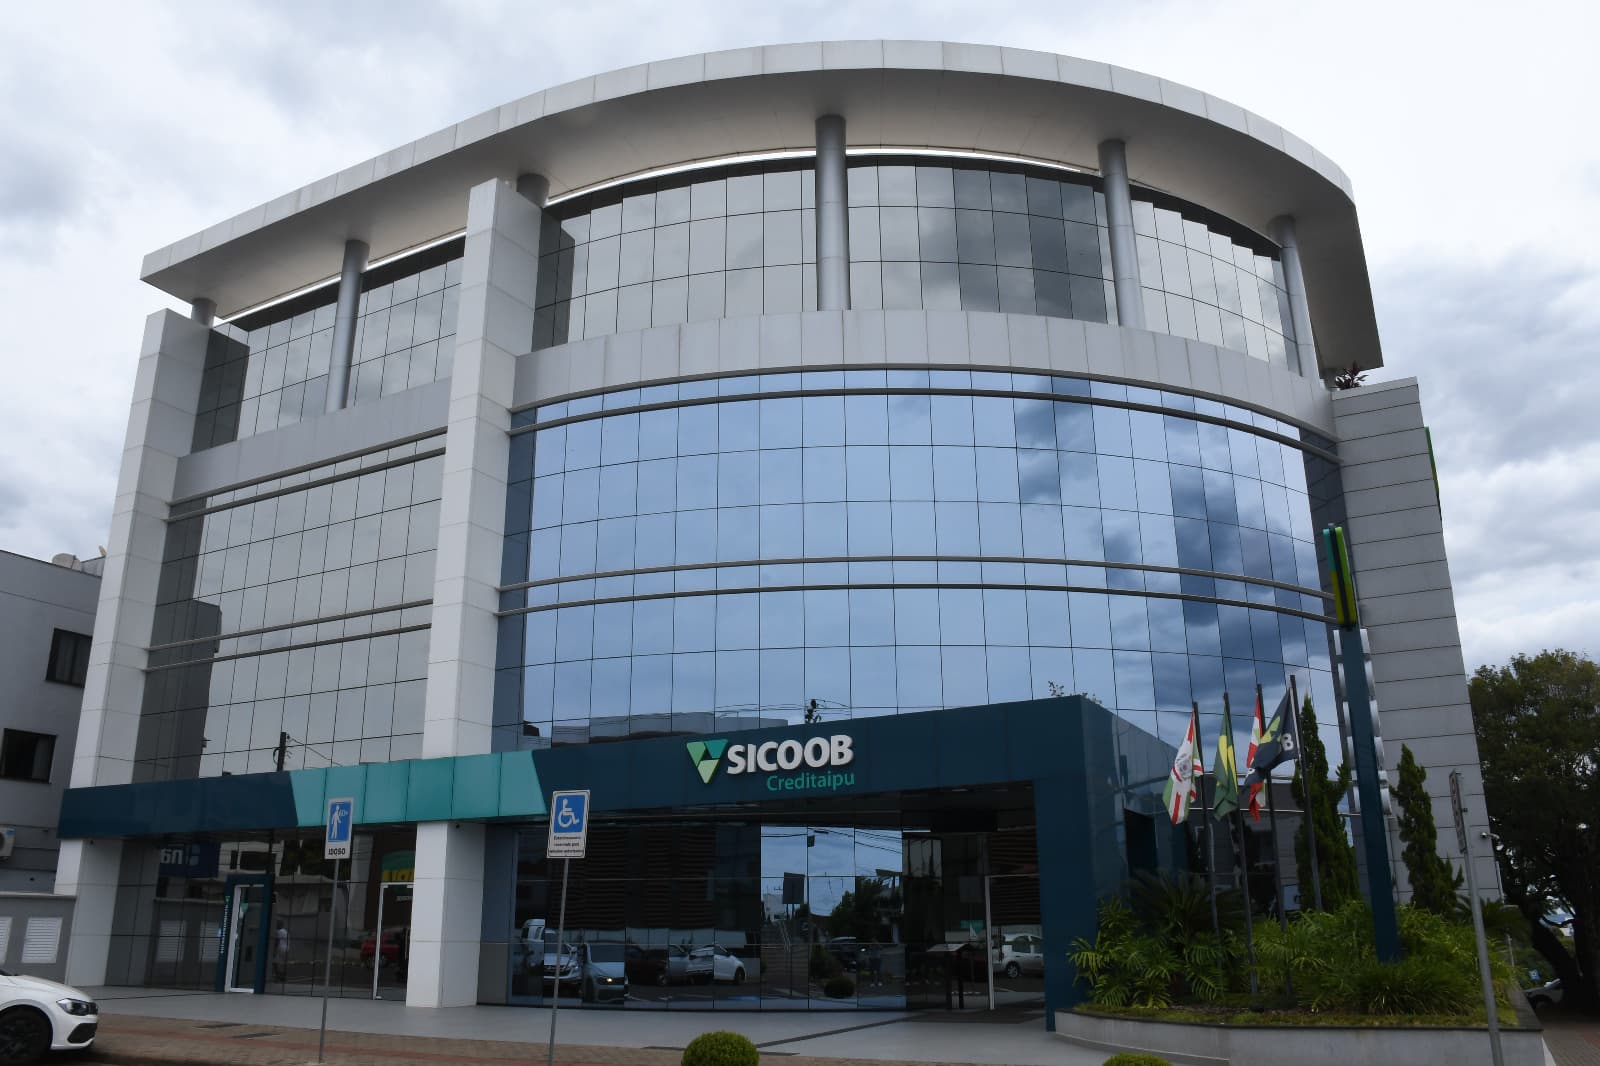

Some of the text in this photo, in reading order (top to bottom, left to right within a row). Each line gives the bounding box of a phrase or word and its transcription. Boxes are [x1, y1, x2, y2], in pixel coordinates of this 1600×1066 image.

[727, 734, 854, 775] SICOOB
[766, 770, 855, 791] Creditaipu
[328, 847, 346, 856] IDOSO
